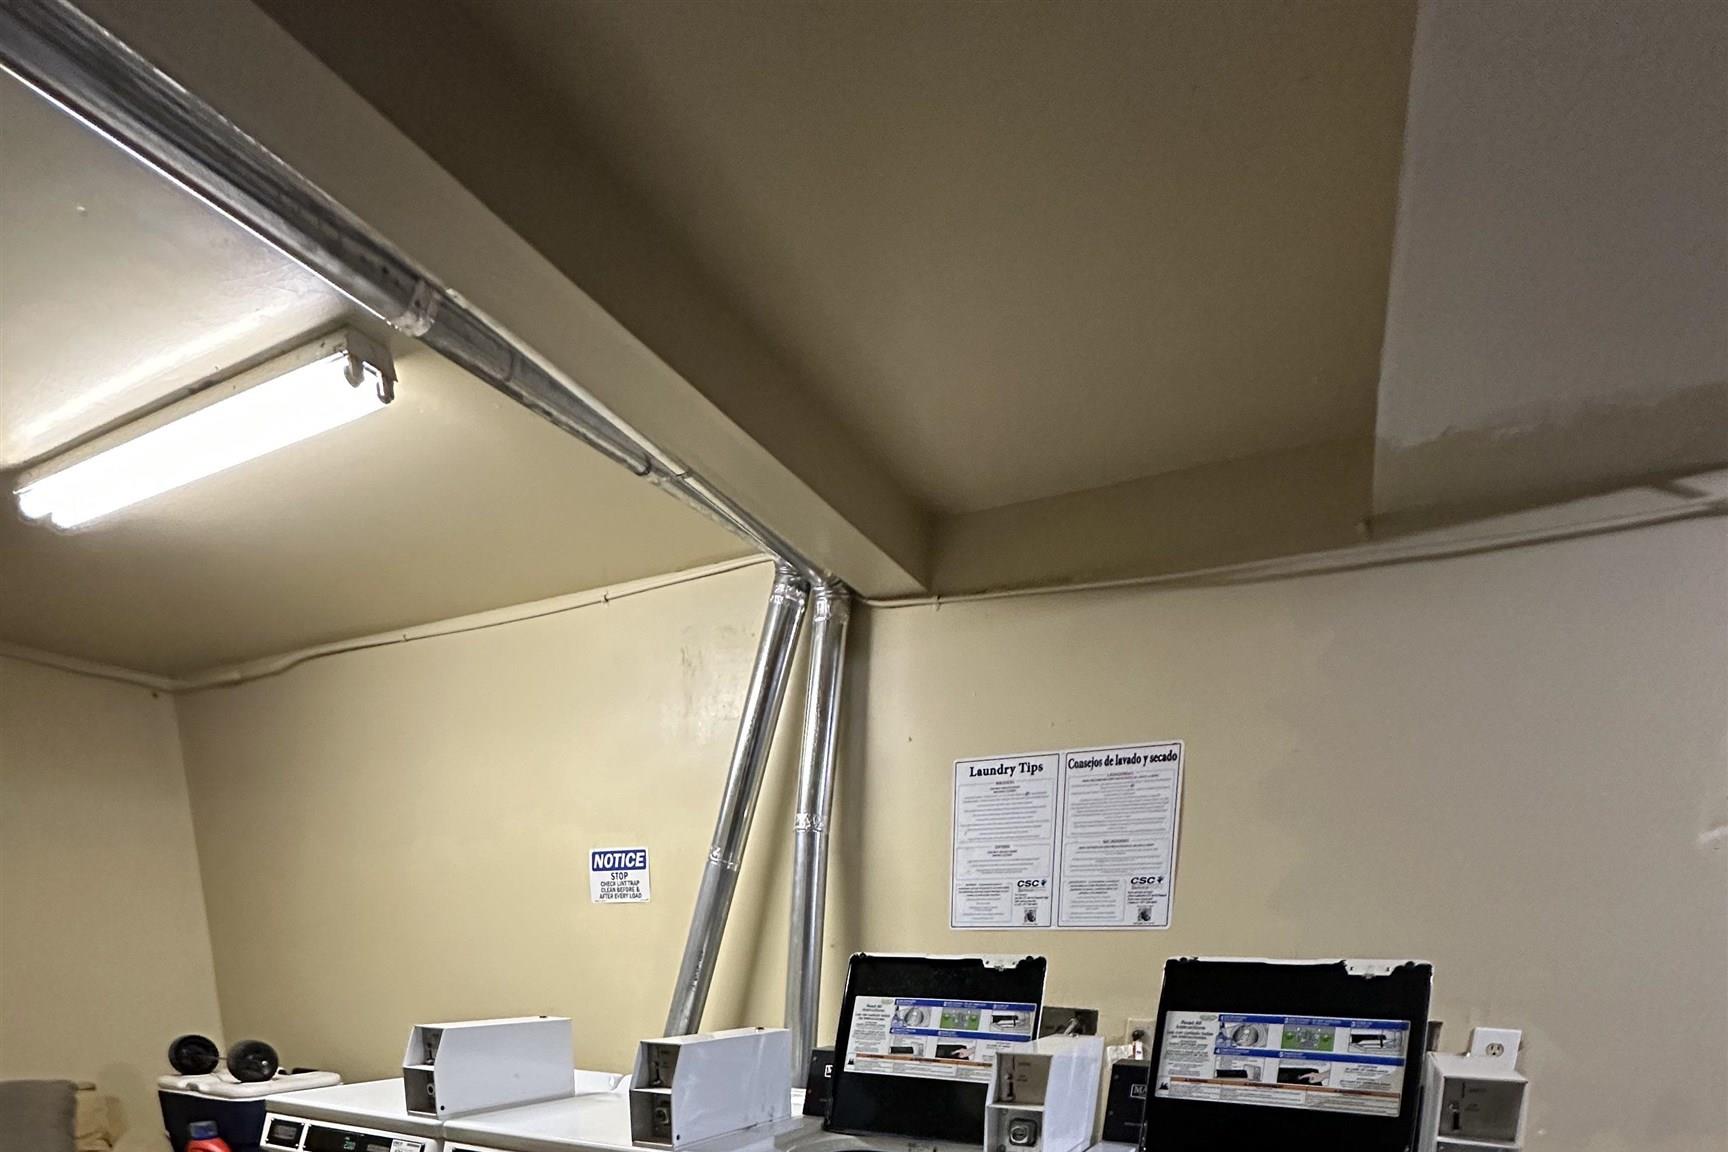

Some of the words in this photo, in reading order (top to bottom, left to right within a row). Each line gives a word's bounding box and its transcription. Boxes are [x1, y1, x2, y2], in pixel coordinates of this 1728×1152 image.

[1067, 754, 1103, 771] Consejos
[1104, 753, 1115, 767] de
[1116, 752, 1142, 766] lavado
[1143, 754, 1149, 767] y
[1149, 749, 1178, 762] secado
[969, 764, 1017, 778] Laundry
[1019, 761, 1044, 775] Tips
[593, 852, 645, 869] NOTICE
[610, 871, 629, 880] STOP
[1130, 876, 1156, 885] CSC
[1017, 879, 1040, 888] CSC
